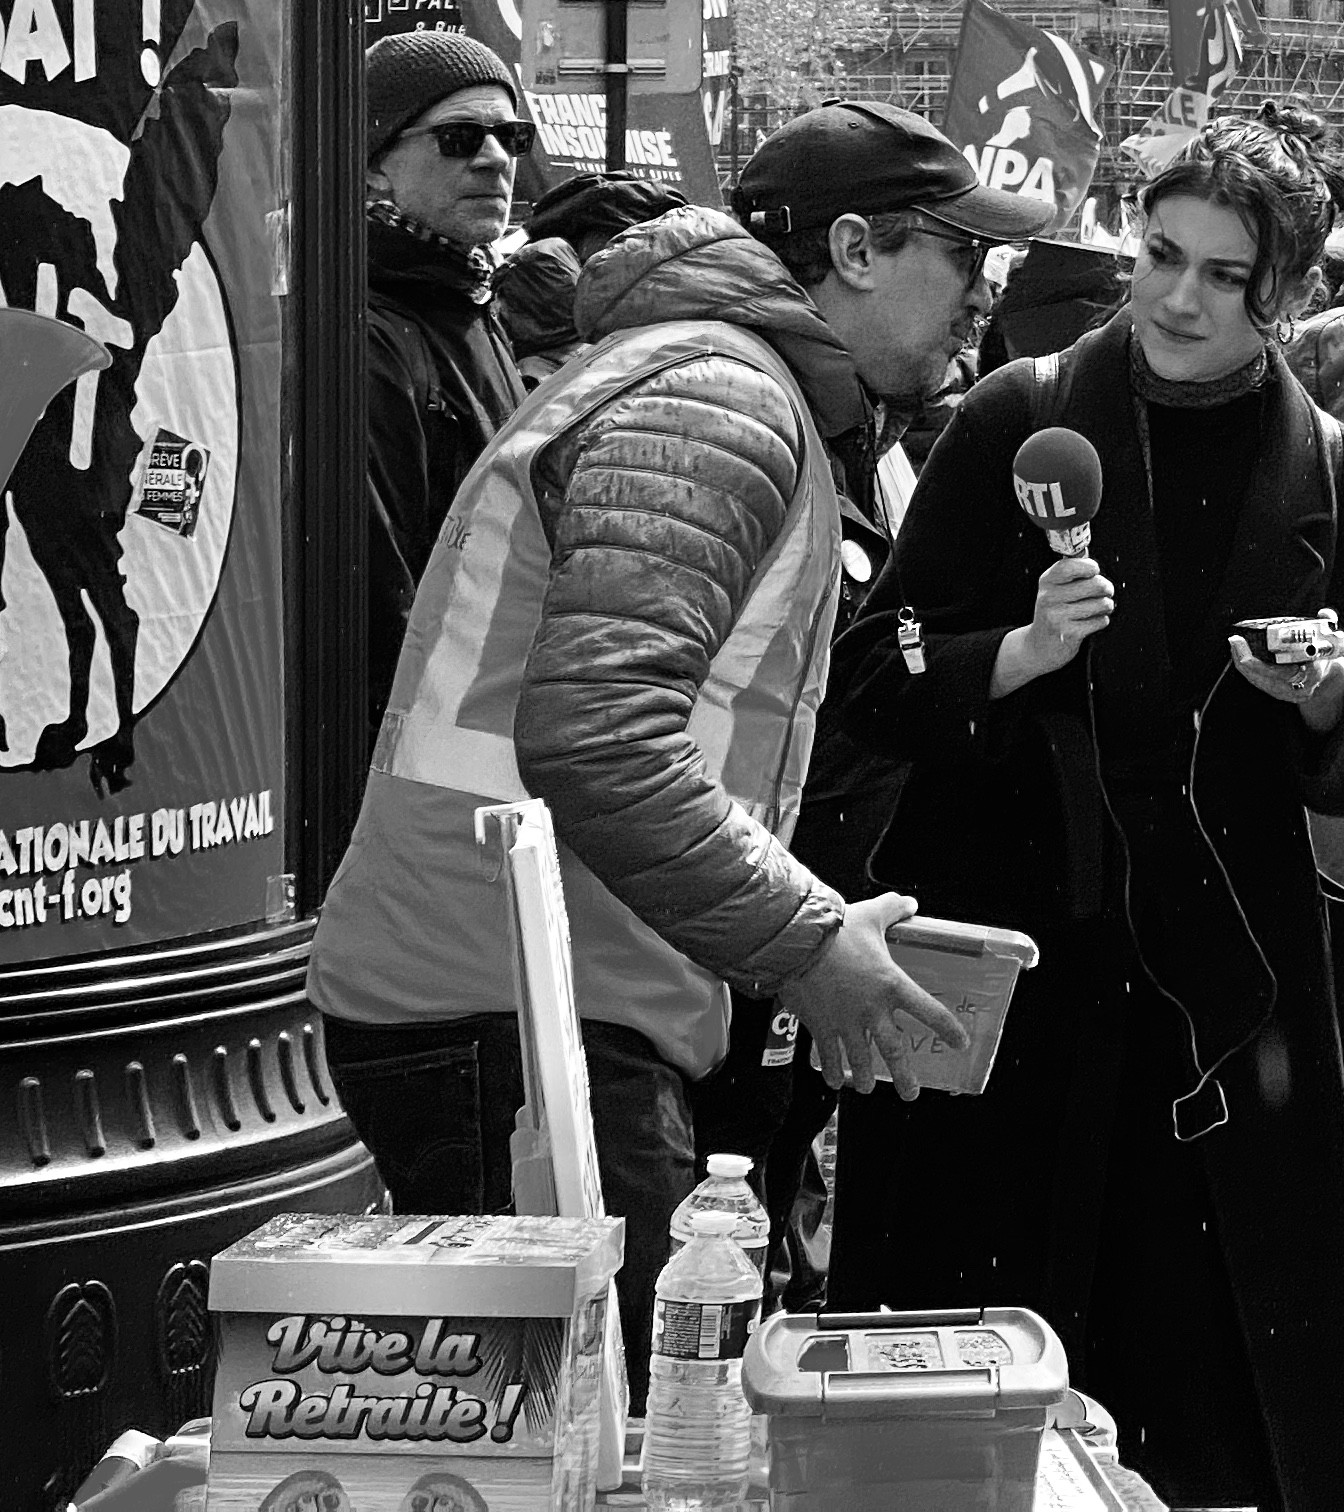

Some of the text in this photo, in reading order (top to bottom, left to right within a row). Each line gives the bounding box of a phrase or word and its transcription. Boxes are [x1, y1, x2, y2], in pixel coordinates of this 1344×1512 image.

[523, 90, 607, 130] FRANC
[962, 144, 1056, 205] NPA
[1014, 474, 1076, 518] RTL
[152, 808, 186, 858] DU
[189, 789, 274, 851] TRAVAIL
[266, 1315, 484, 1376] Vive la
[240, 1378, 488, 1442] Retraite
